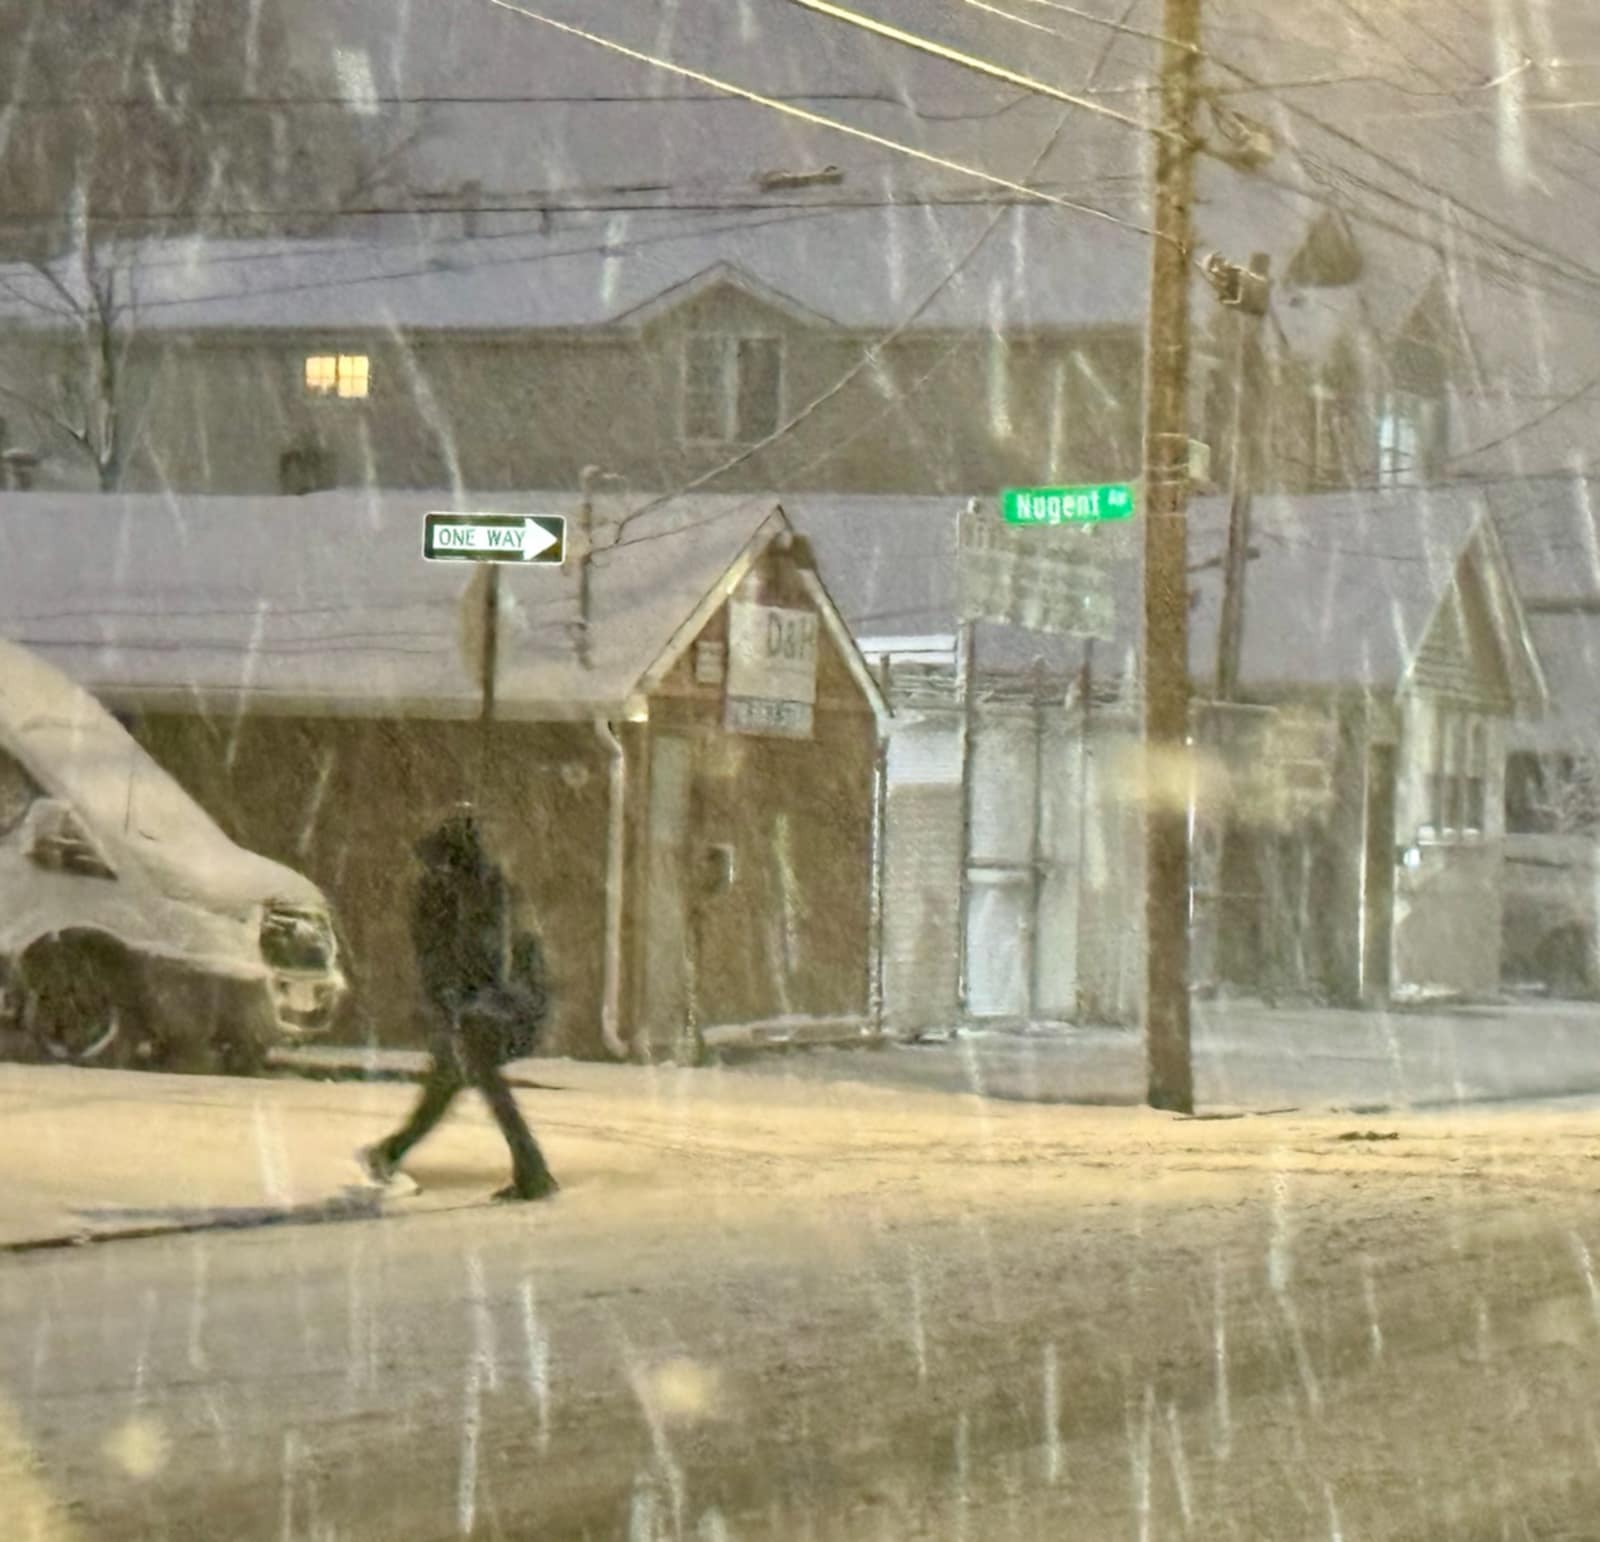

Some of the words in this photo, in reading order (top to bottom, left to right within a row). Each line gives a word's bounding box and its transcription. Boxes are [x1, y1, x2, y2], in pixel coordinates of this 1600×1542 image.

[1016, 490, 1098, 525] Nugent
[438, 528, 476, 546] ONE
[487, 529, 524, 548] WAY
